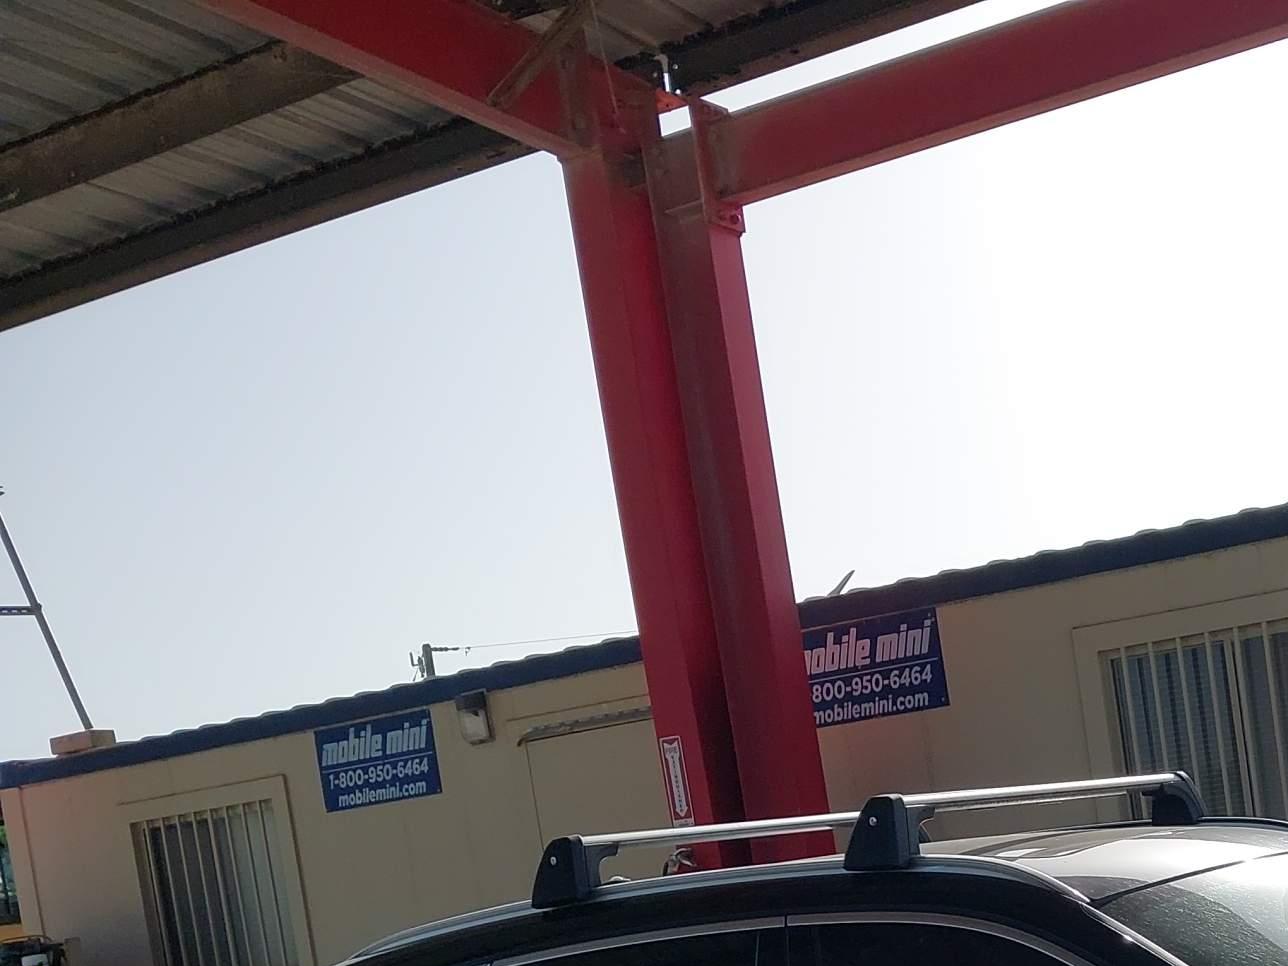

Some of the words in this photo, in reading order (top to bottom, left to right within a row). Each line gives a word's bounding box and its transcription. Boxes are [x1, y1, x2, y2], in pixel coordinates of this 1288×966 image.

[876, 619, 932, 663] mini
[321, 723, 383, 766] mobile
[386, 719, 428, 754] mini
[329, 757, 429, 790] 1-800-950-6464
[338, 781, 427, 807] mobilemini.com
